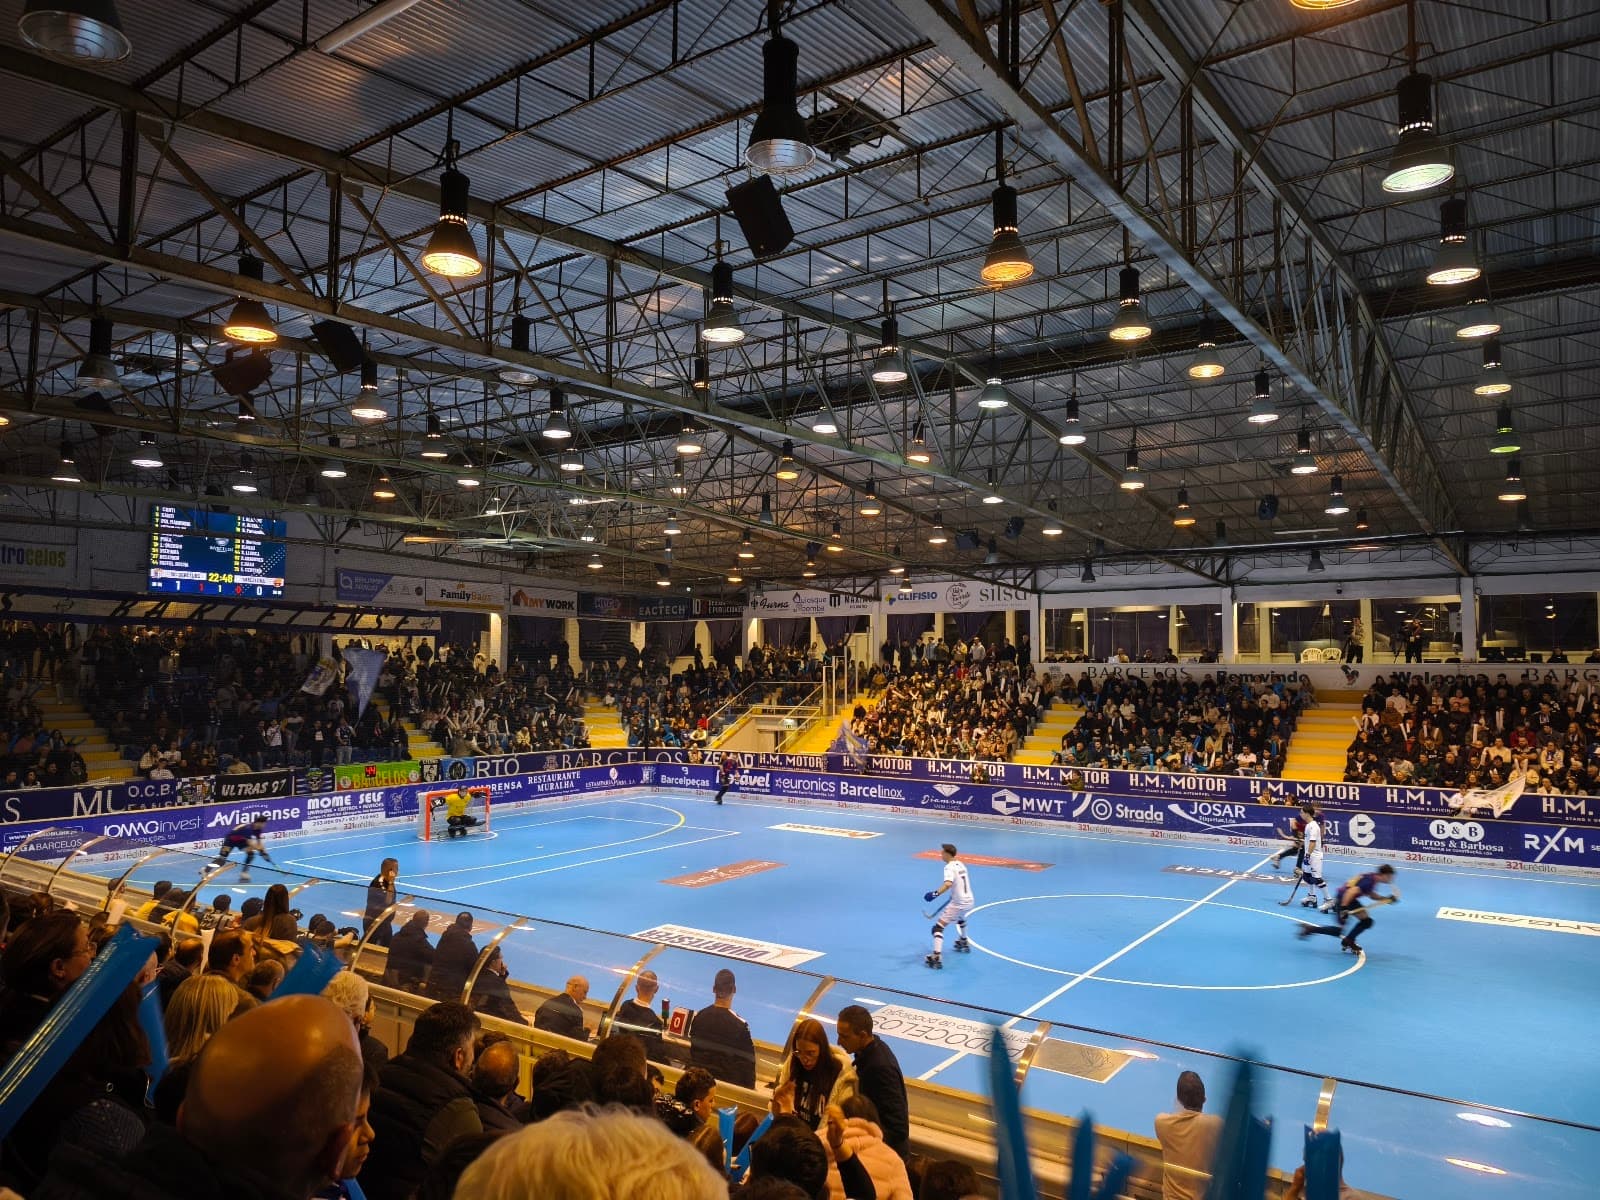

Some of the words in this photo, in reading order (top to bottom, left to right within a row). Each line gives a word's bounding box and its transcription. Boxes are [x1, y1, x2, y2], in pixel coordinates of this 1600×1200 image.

[208, 573, 234, 583] 22:48
[545, 599, 575, 610] WORK
[898, 591, 938, 602] CLIFISIO
[785, 755, 823, 769] MOTOR
[872, 757, 912, 770] MOTOR
[928, 759, 956, 774] H.M.
[528, 771, 581, 785] RESTAURANTE
[660, 775, 710, 788] Barcelpeças
[1023, 766, 1056, 781] H.M.
[1060, 768, 1110, 785] MTOR
[1130, 773, 1166, 788] H.M.
[1171, 775, 1227, 792] MOTOR
[128, 782, 174, 798] O.C.B.
[221, 781, 269, 797] ULTRAS
[537, 780, 575, 793] MURALHA
[782, 777, 836, 793] euronics
[840, 781, 904, 800] Barcelinox
[1296, 783, 1360, 801] MOTOR
[1386, 788, 1432, 806] H.M.
[1022, 797, 1064, 815] MWT
[1115, 803, 1164, 822] Strada
[1189, 801, 1247, 820] JOSAR
[1542, 797, 1594, 816] H.M.
[207, 807, 301, 828] Avianense
[1411, 836, 1447, 848] Barros
[1448, 840, 1458, 849] &
[1460, 841, 1504, 853] Barbosa
